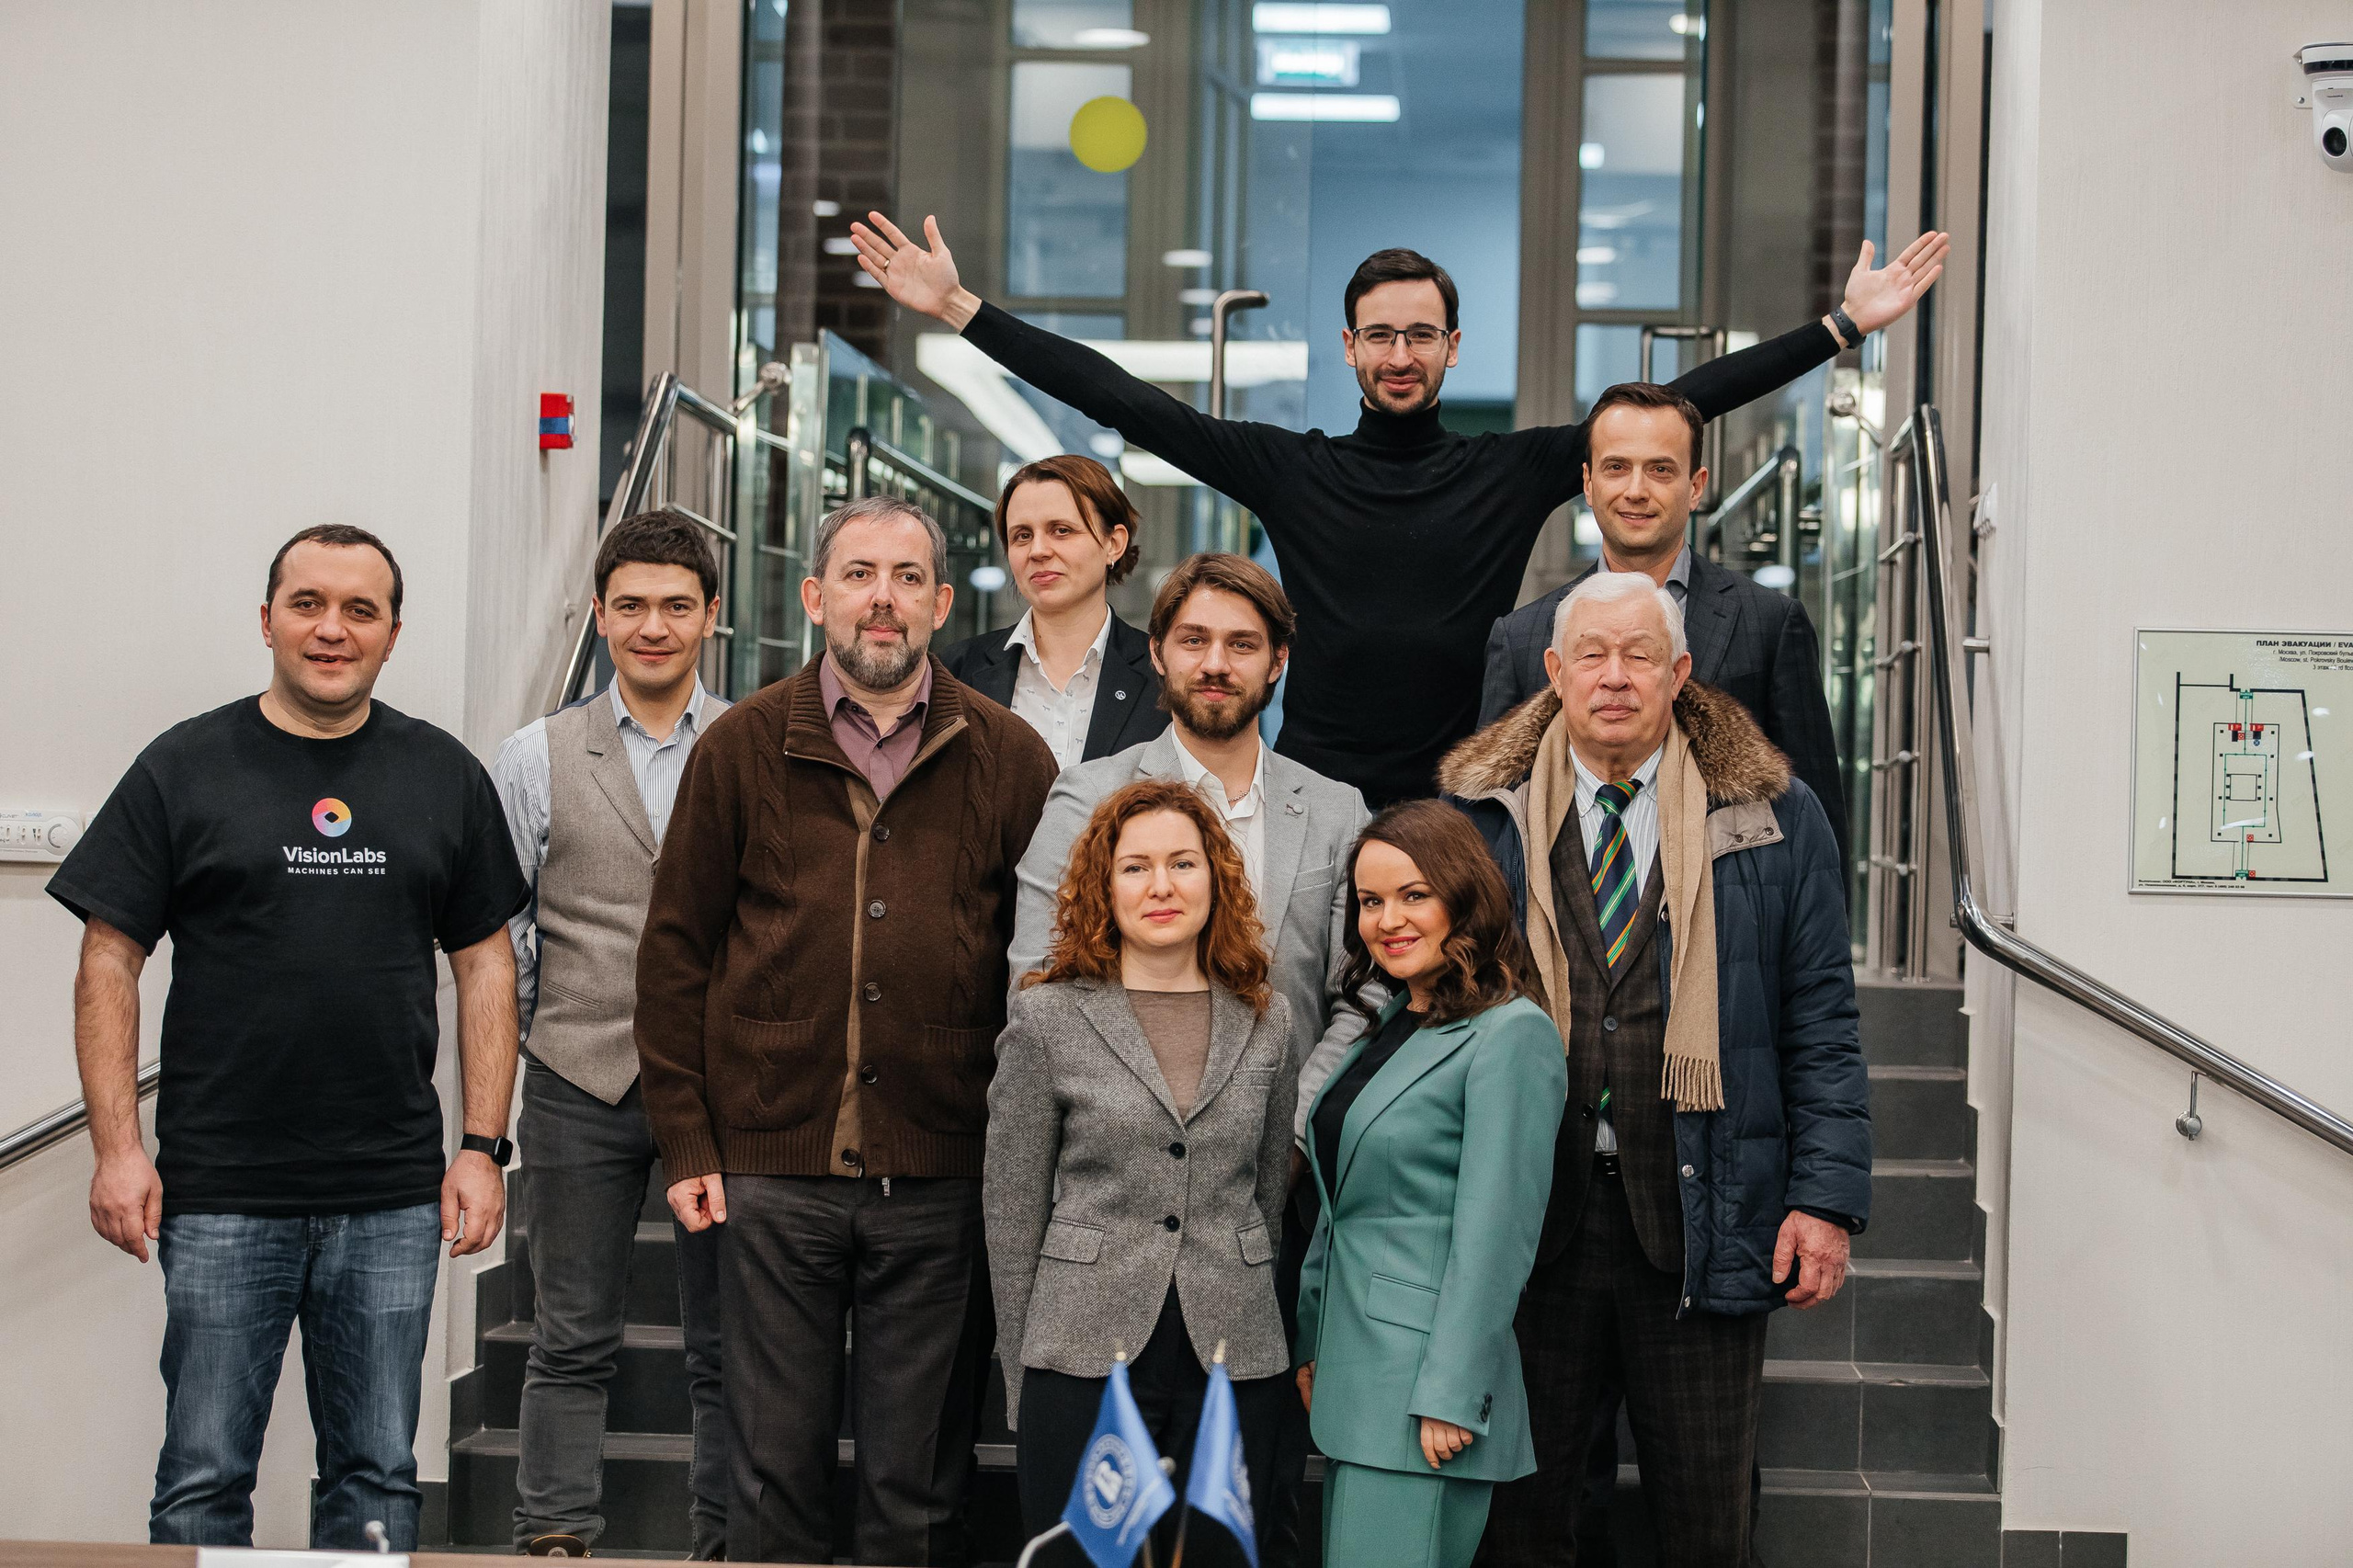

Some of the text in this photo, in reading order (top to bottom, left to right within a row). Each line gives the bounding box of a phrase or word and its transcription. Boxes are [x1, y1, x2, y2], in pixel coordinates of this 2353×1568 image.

[2281, 640, 2332, 648] ЭВАКУАЦИИ
[282, 846, 387, 864] VisionLabs
[288, 867, 339, 875] MACHINES
